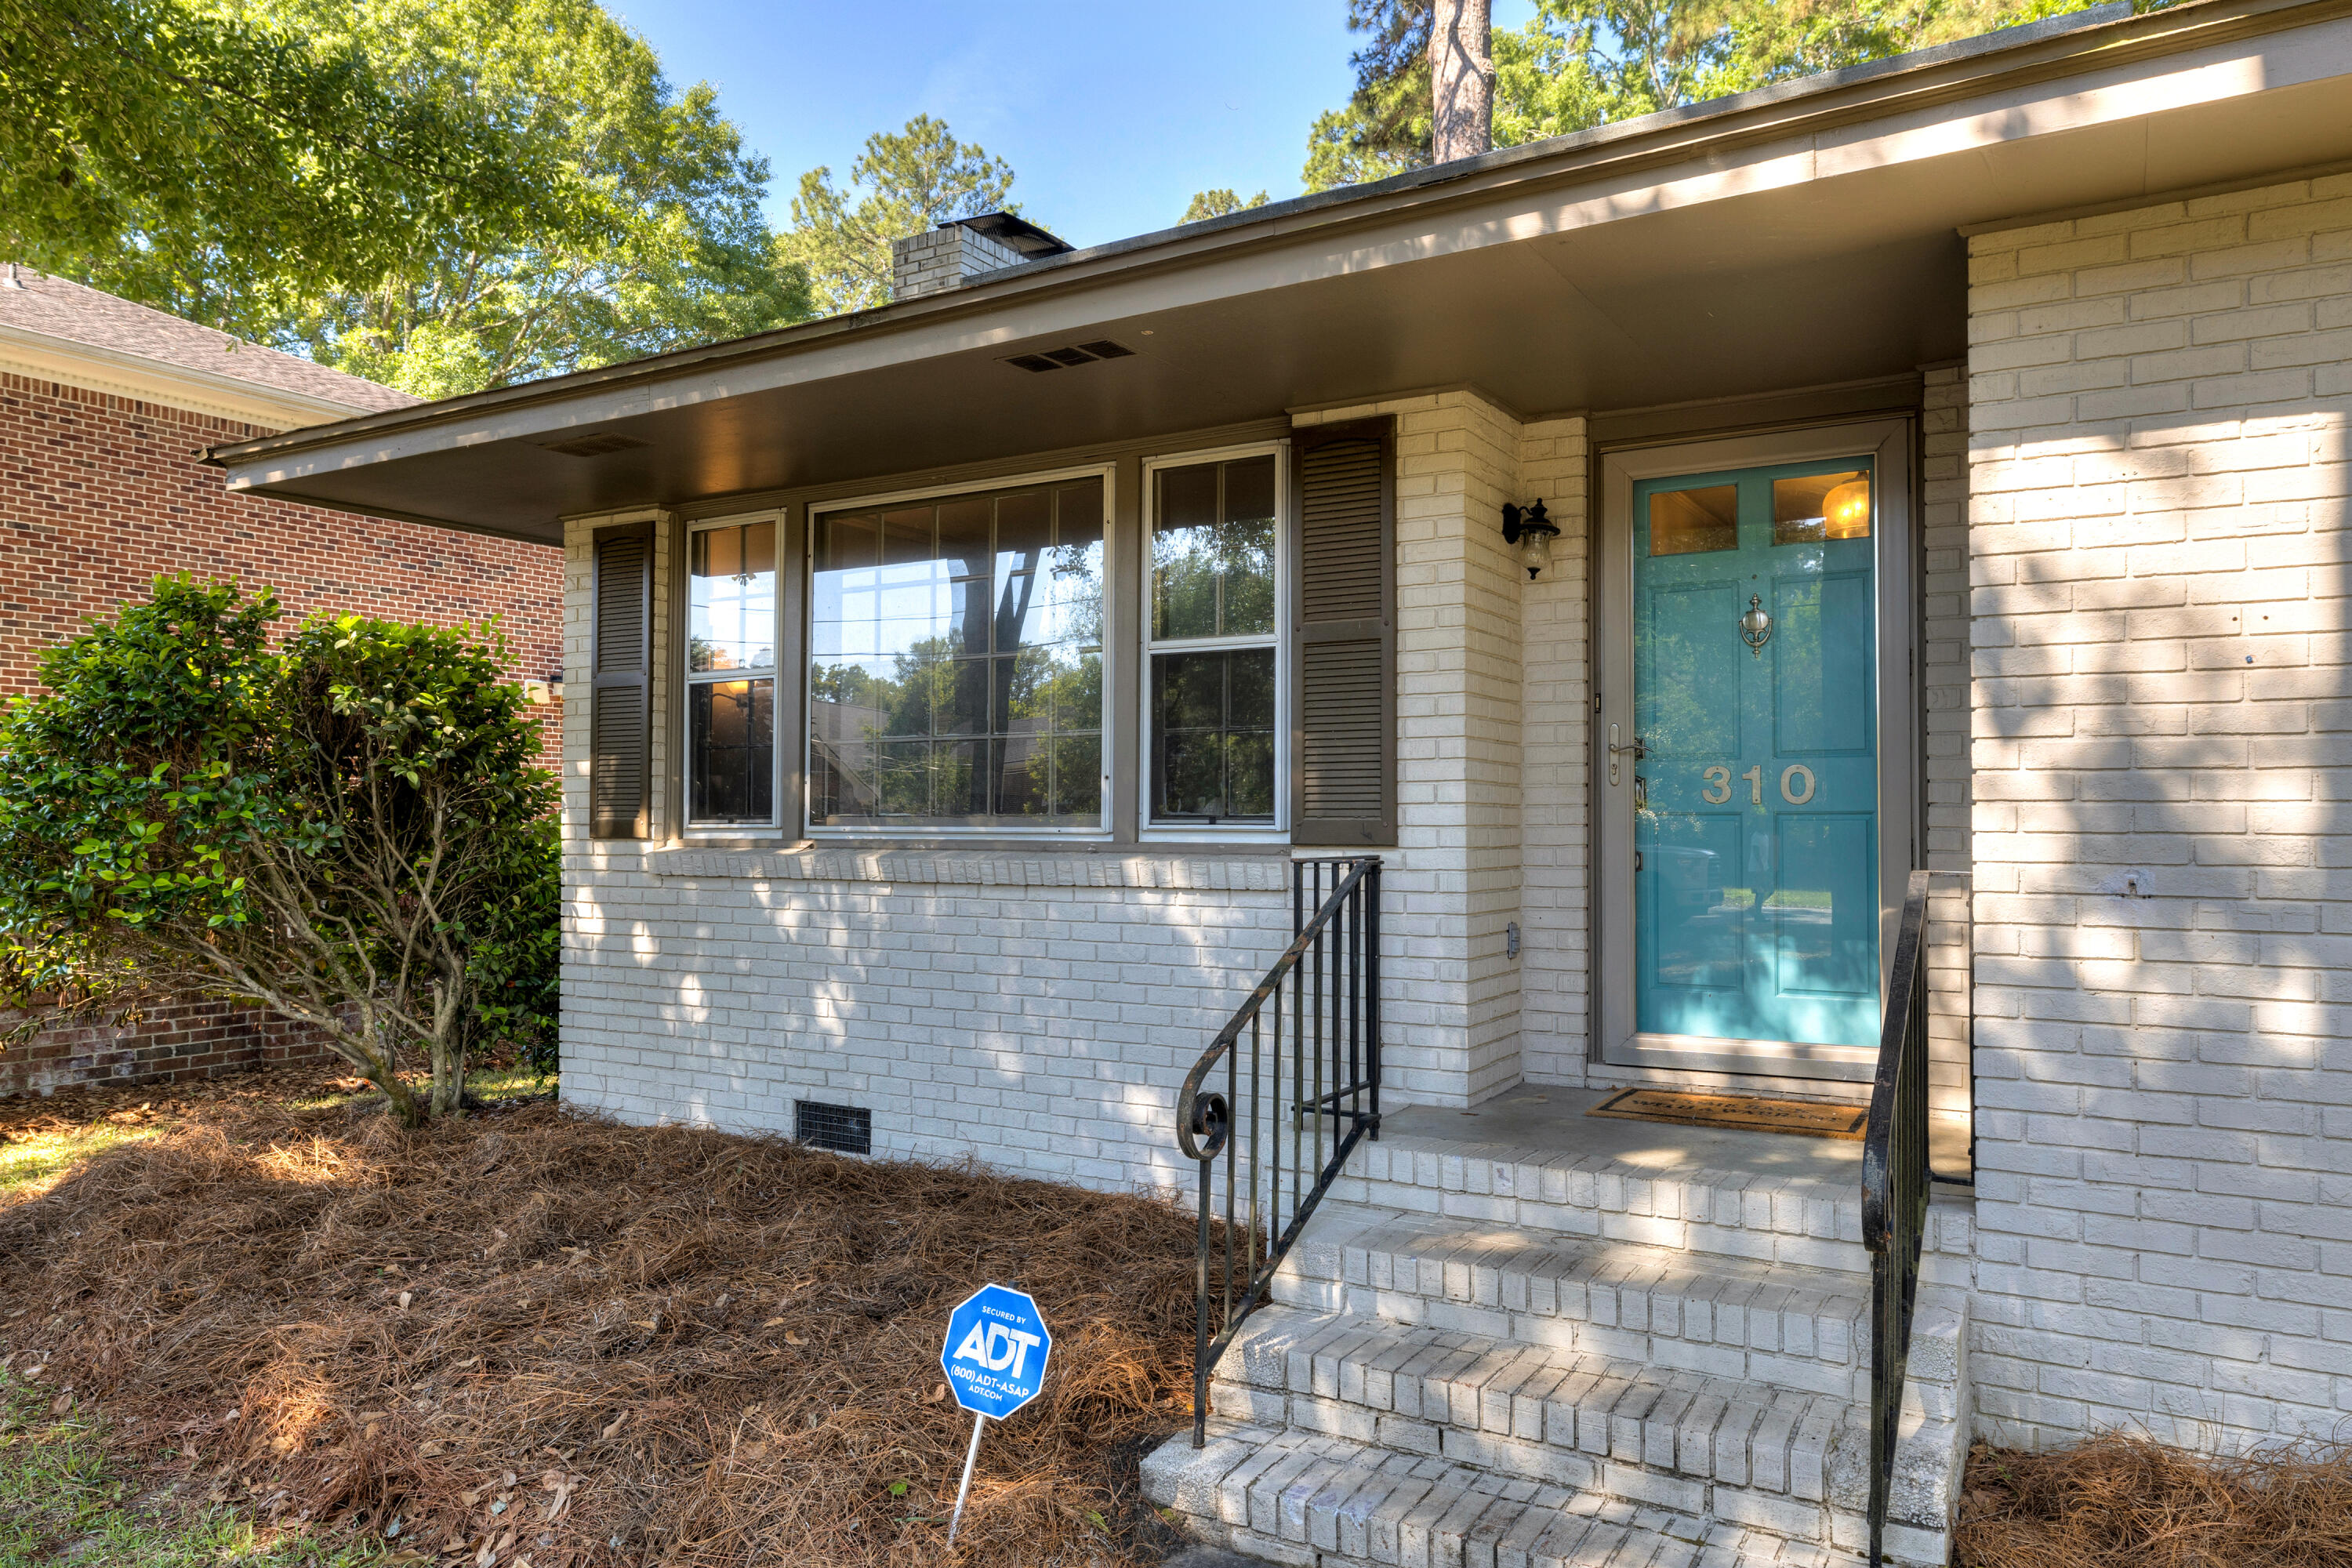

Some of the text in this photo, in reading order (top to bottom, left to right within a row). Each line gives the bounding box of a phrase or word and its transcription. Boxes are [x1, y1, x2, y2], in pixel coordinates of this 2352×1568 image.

[1701, 764, 1816, 805] 310
[982, 1305, 1026, 1324] SECURED BY
[952, 1319, 1041, 1379] ADT
[968, 1384, 1003, 1402] ADT.COM
